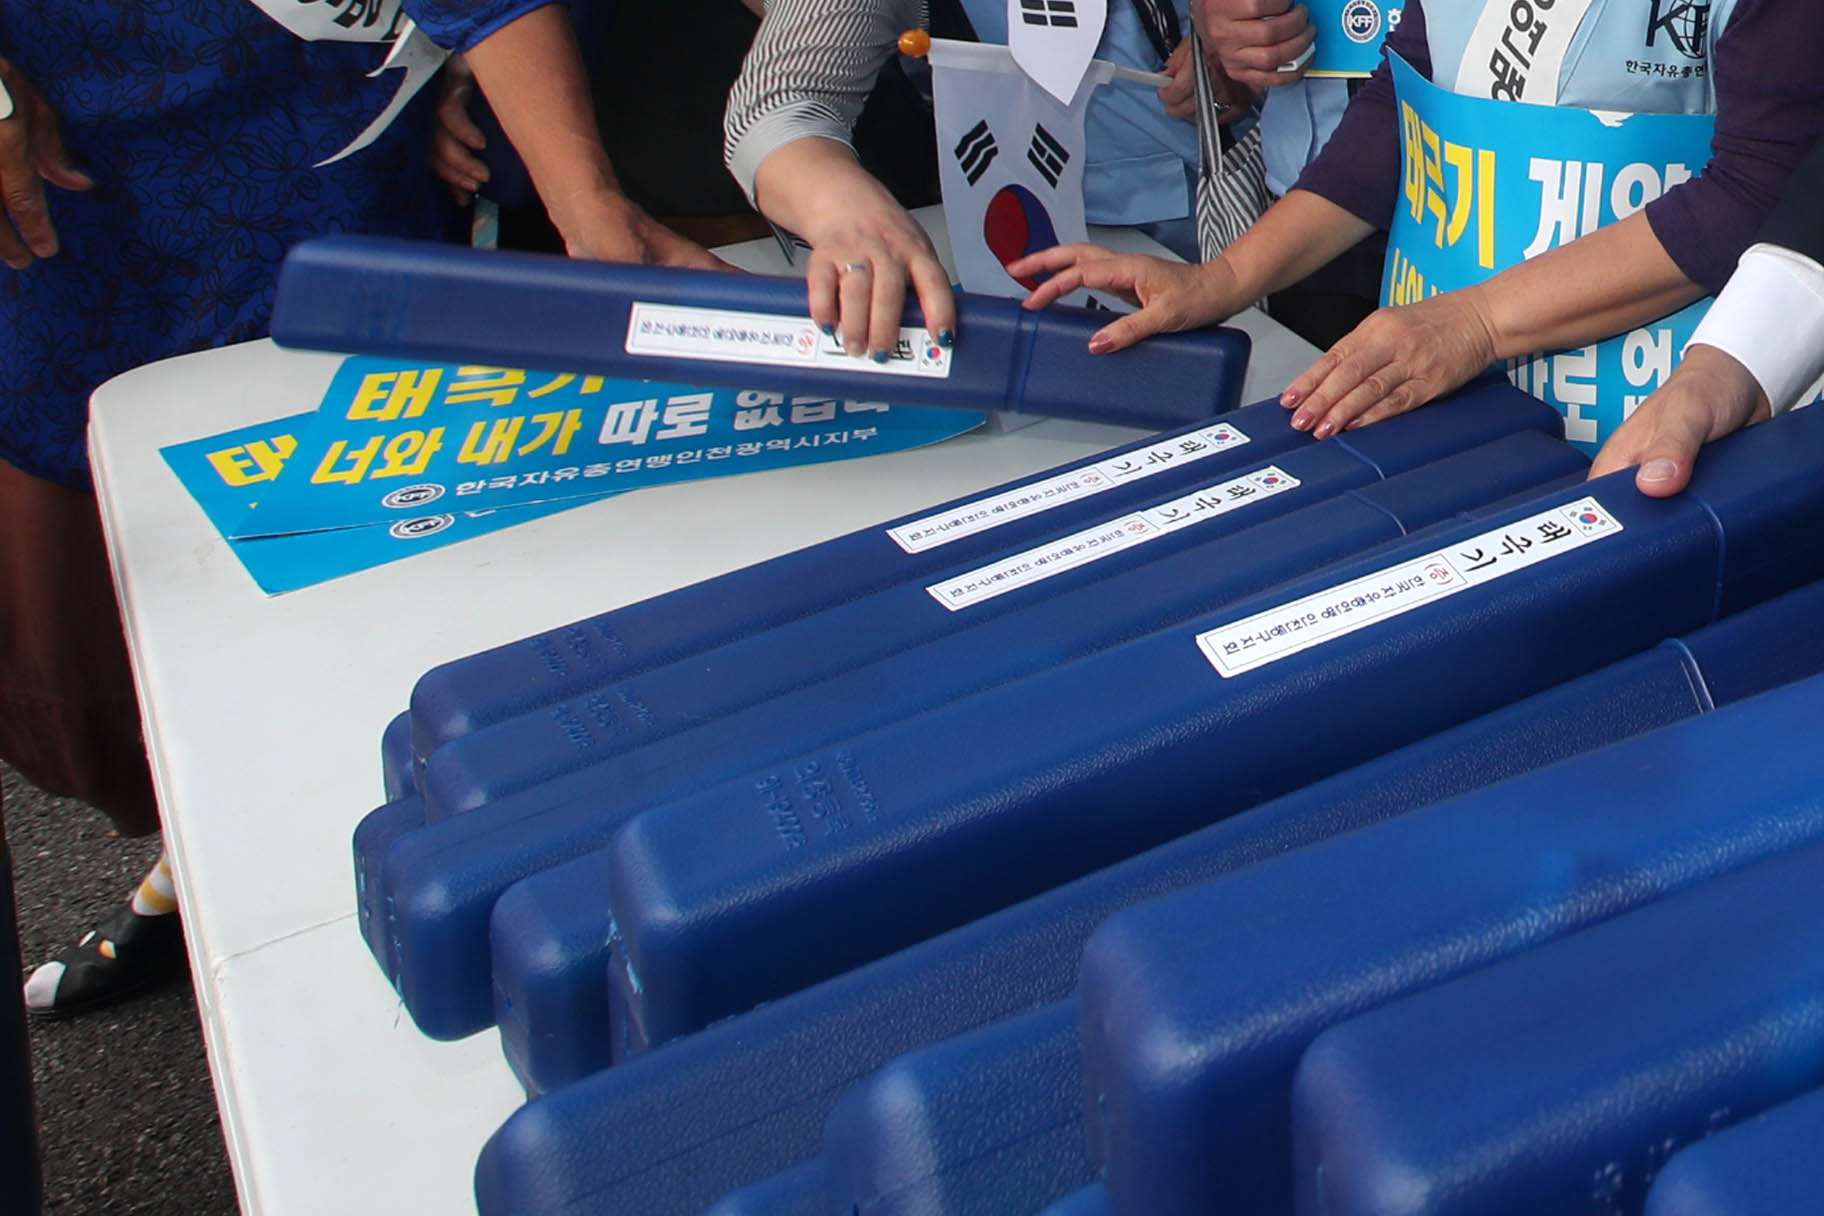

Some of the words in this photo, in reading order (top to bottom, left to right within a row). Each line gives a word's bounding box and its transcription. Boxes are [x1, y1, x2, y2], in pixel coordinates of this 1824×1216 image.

[1625, 59, 1708, 78] 한국자유총연
[1400, 99, 1496, 270] 태극기
[310, 427, 447, 486] 너와
[457, 408, 583, 466] 내가
[598, 391, 715, 447] 따로
[1459, 520, 1573, 572] 태극기
